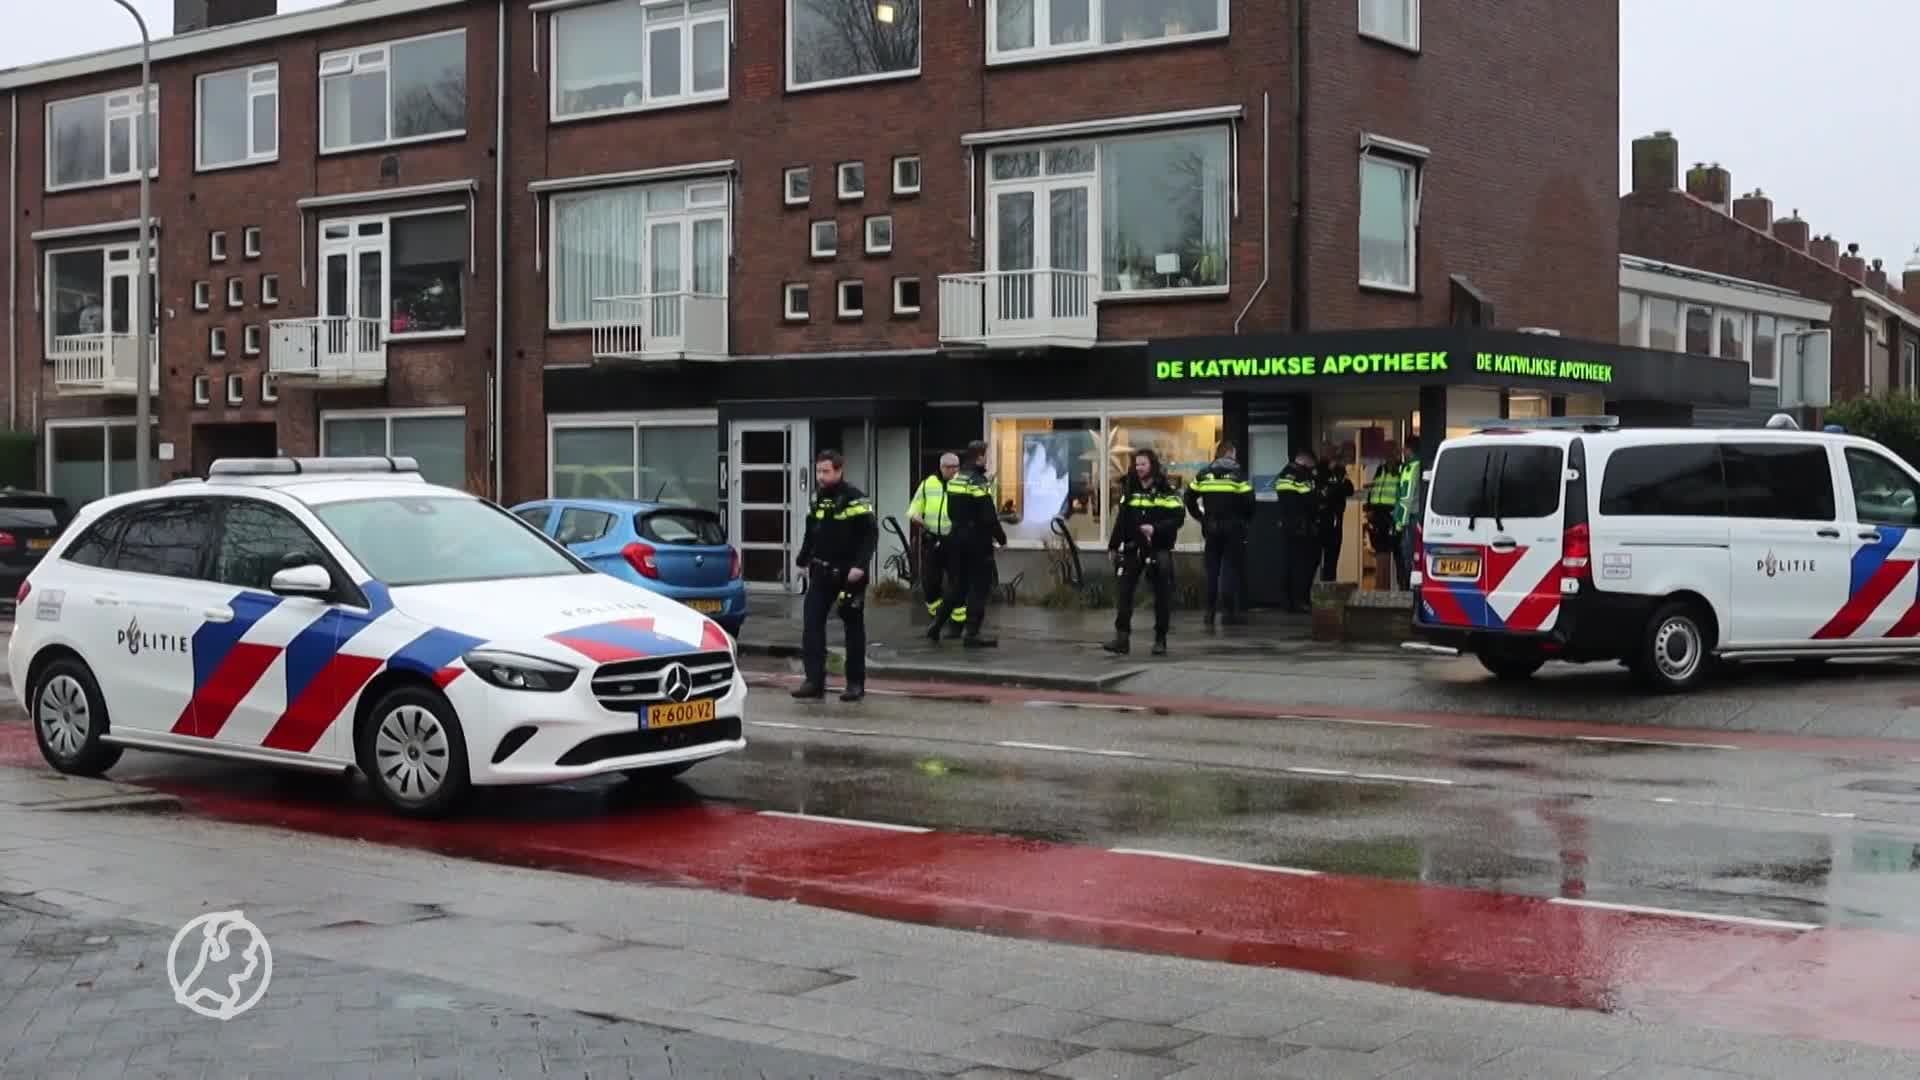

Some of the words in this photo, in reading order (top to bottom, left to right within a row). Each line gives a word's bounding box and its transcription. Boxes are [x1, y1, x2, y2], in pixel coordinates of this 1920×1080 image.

[1156, 360, 1184, 378] DE
[1190, 357, 1316, 378] KATWIJKSE
[1322, 352, 1448, 373] APOTHEEK
[1476, 353, 1492, 371] DE
[1495, 354, 1556, 376] KATWIJKSE
[1560, 360, 1612, 382] APOTHEEK
[1757, 553, 1816, 577] POLITIE
[118, 621, 187, 654] POLITIE
